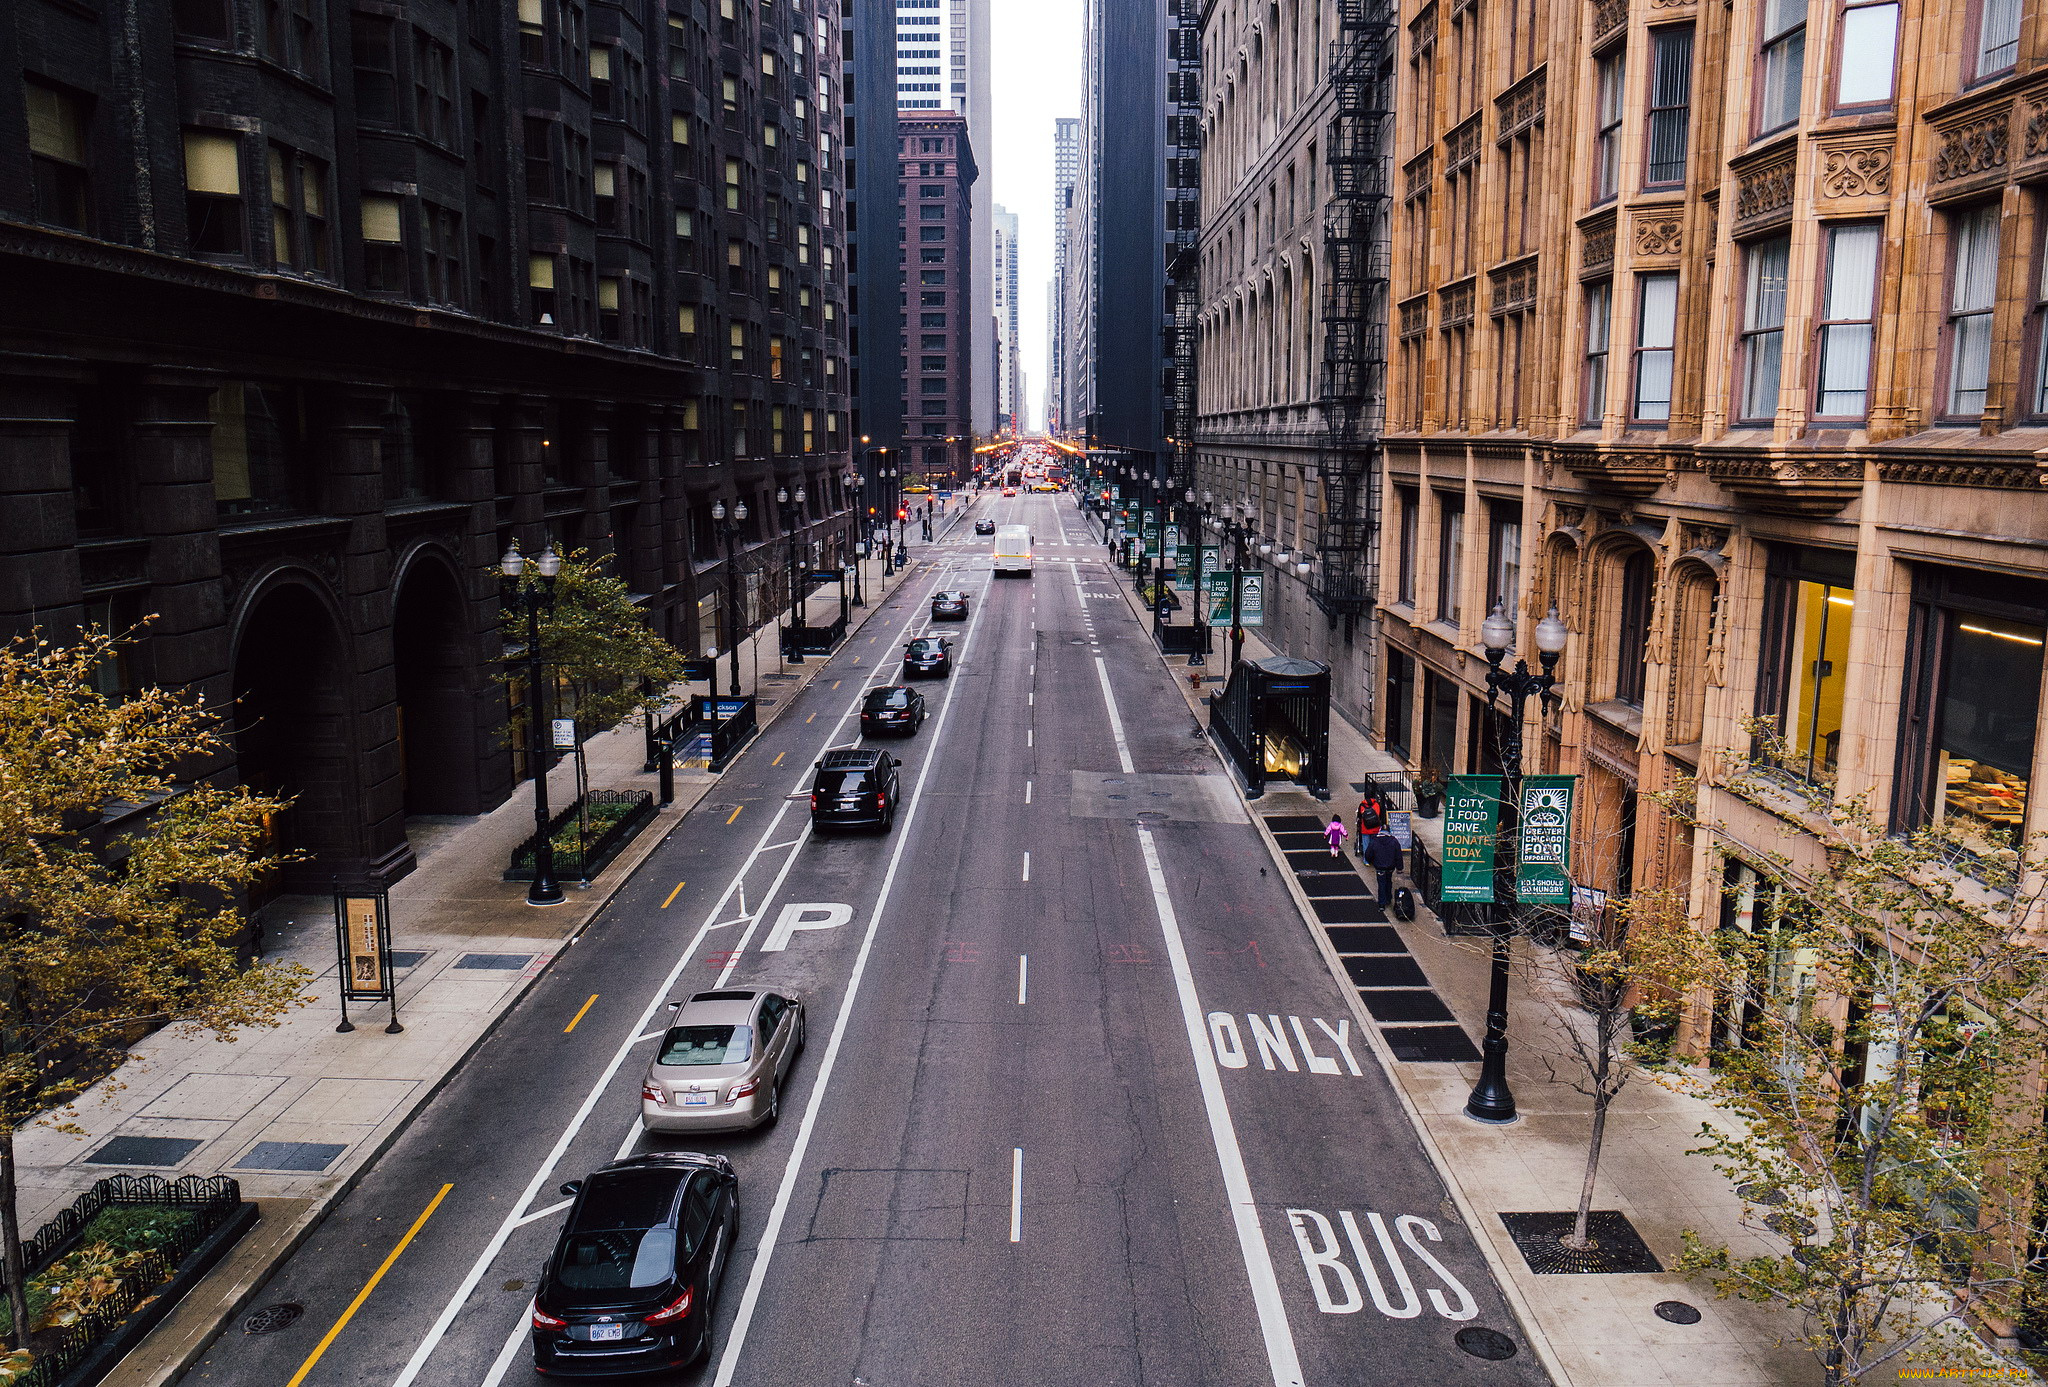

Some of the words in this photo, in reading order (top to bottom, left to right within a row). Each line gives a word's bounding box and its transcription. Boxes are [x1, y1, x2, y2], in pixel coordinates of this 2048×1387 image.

[1449, 797, 1456, 807] 1
[1459, 798, 1484, 809] CITY,
[1448, 808, 1455, 819] 1
[1458, 811, 1488, 821] FOOD
[1447, 822, 1482, 833] DRIVE.
[1446, 835, 1491, 846] DONATE
[1446, 847, 1481, 858] TODAY.
[1525, 843, 1562, 854] FOOD
[760, 903, 853, 952] P
[1206, 1011, 1363, 1076] ONLY
[1286, 1208, 1480, 1321] BUS
[592, 1329, 605, 1339] 862
